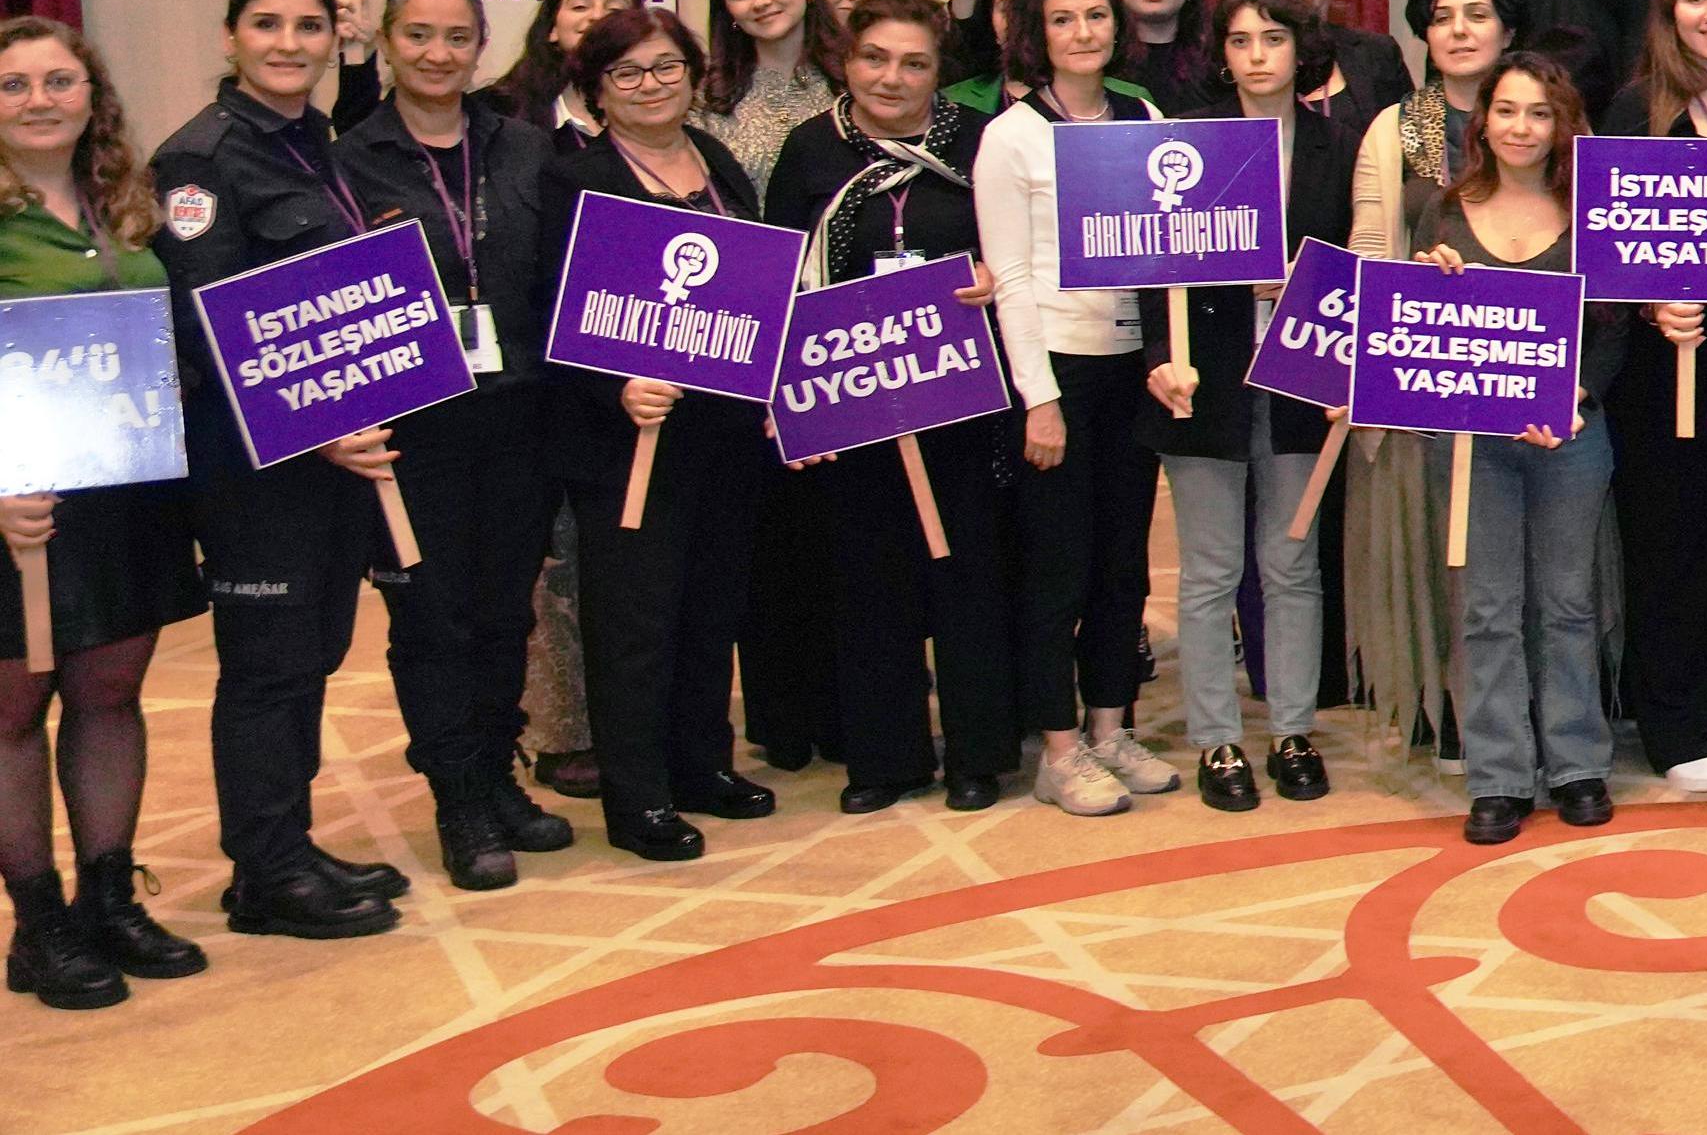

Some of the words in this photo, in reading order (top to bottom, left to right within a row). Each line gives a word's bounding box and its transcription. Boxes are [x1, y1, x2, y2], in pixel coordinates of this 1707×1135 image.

[1082, 210, 1165, 258] BİRLİKTE
[1165, 204, 1261, 261] GÜÇLÜYÜZ
[238, 290, 439, 387] SÖZLEŞMESİ
[244, 273, 407, 344] İSTANBUL
[579, 288, 667, 347] BİRLİKTE
[663, 304, 761, 364] GÜÇLÜYÜZ
[800, 304, 943, 367] 6284'Ü
[1391, 292, 1547, 333] İSTANBUL
[276, 340, 424, 411] YAŞATIR!
[781, 333, 982, 413] UYGULA!
[1366, 326, 1568, 368] SÖZLEŞMESİ
[1393, 367, 1537, 400] YAŞATIR!
